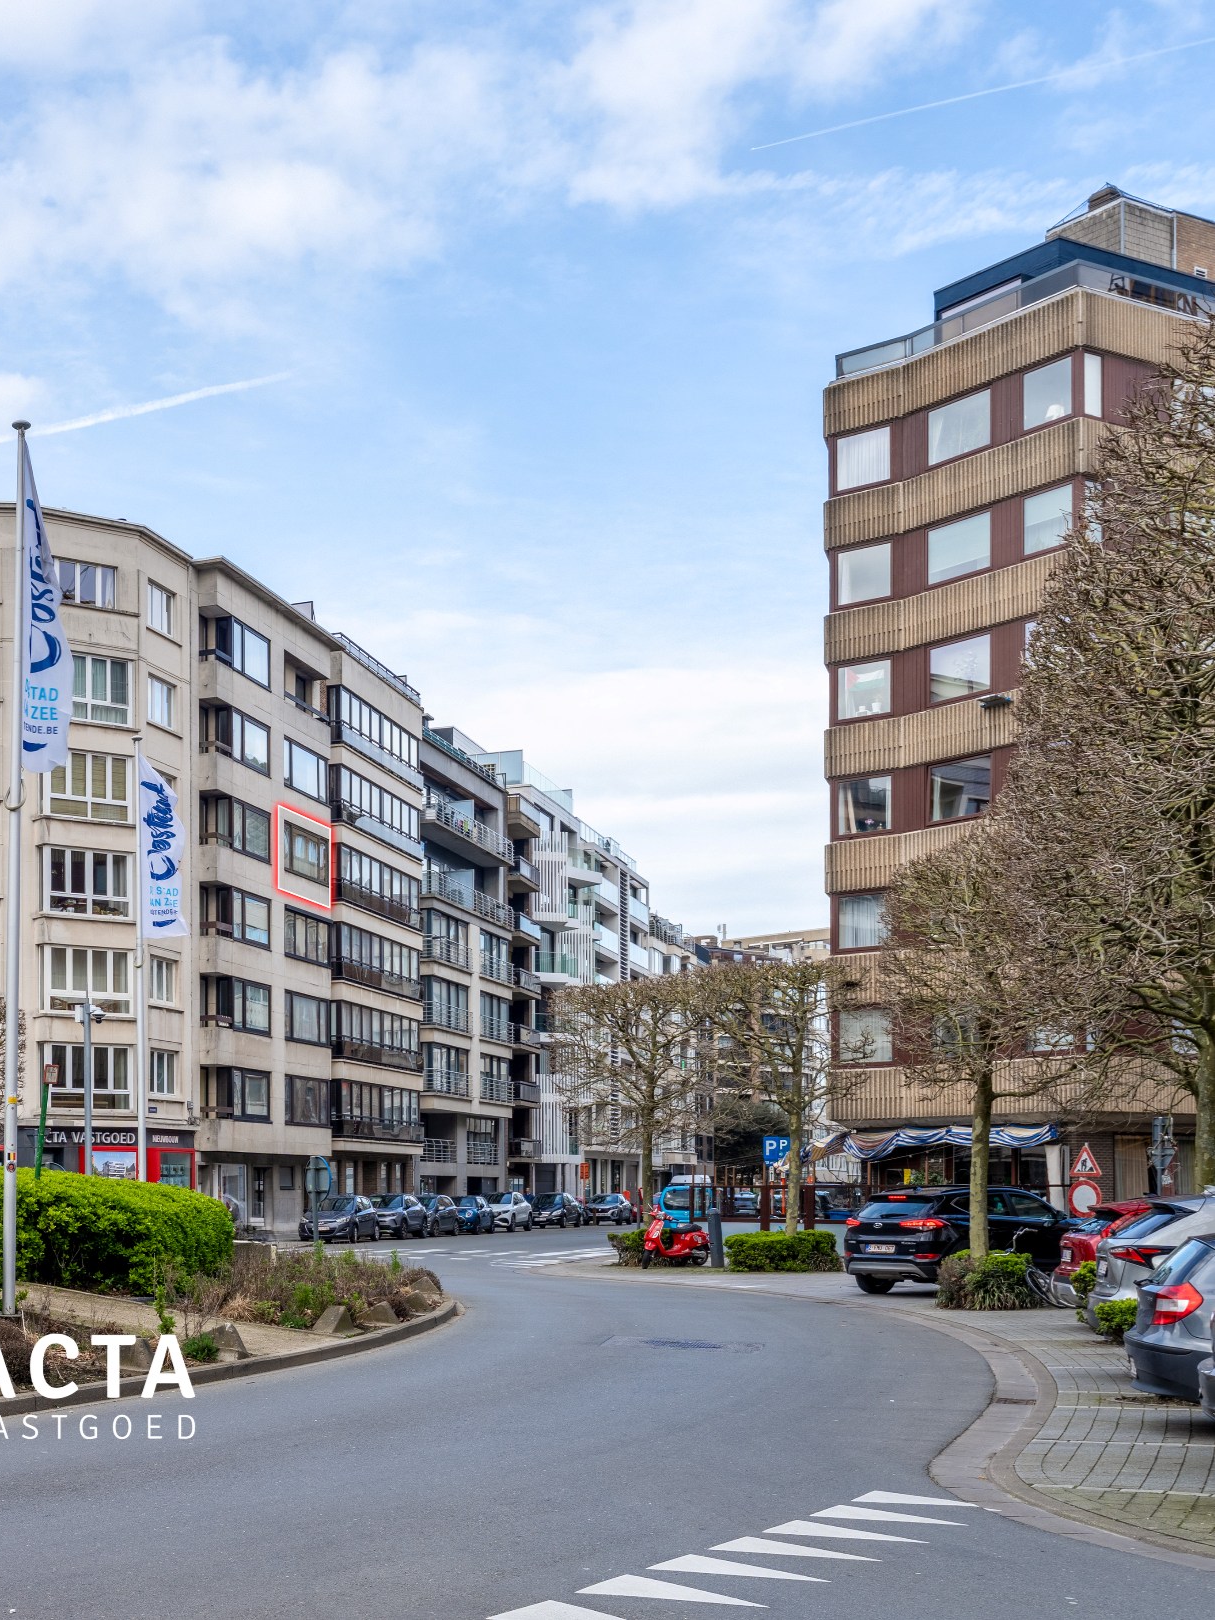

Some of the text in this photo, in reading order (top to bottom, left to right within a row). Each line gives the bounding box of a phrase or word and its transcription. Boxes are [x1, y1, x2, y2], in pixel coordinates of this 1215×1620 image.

[30, 705, 58, 720] ZEE
[156, 886, 178, 897] SAD
[43, 1131, 67, 1143] CTA
[765, 1140, 777, 1156] P
[779, 1139, 788, 1150] P
